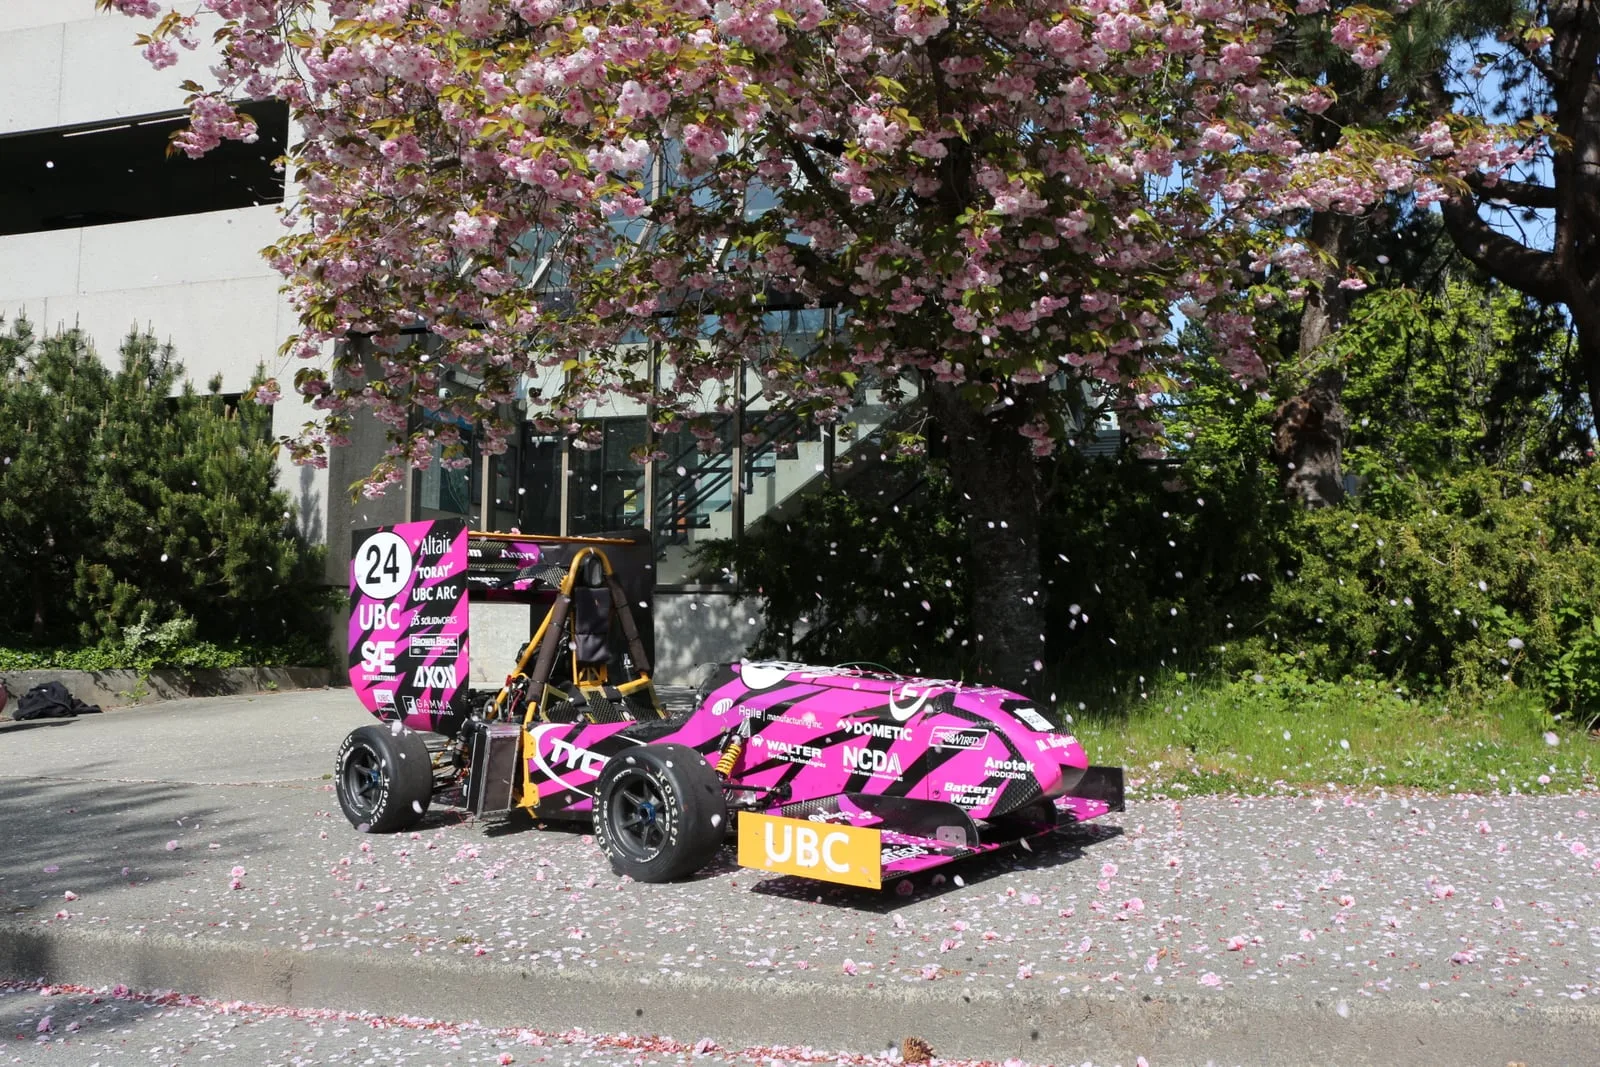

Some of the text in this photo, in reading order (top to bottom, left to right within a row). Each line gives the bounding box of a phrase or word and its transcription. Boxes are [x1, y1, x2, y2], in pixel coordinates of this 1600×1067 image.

[420, 535, 451, 555] Altair
[366, 543, 399, 584] 24
[412, 585, 457, 602] UBC ARC
[360, 603, 400, 630] UBC
[361, 640, 396, 673] SAE
[413, 665, 457, 689] AXON
[416, 699, 452, 710] GAMMA
[739, 705, 761, 719] Agile
[854, 721, 912, 741] DOMETIC
[551, 738, 611, 777] TYC
[766, 740, 822, 758] WALTER
[843, 745, 902, 775] NCDA
[984, 757, 1035, 772] Anotek
[984, 770, 1026, 780] ANODIZING
[944, 782, 997, 797] Battery
[950, 793, 993, 805] World
[765, 822, 849, 873] UBC
